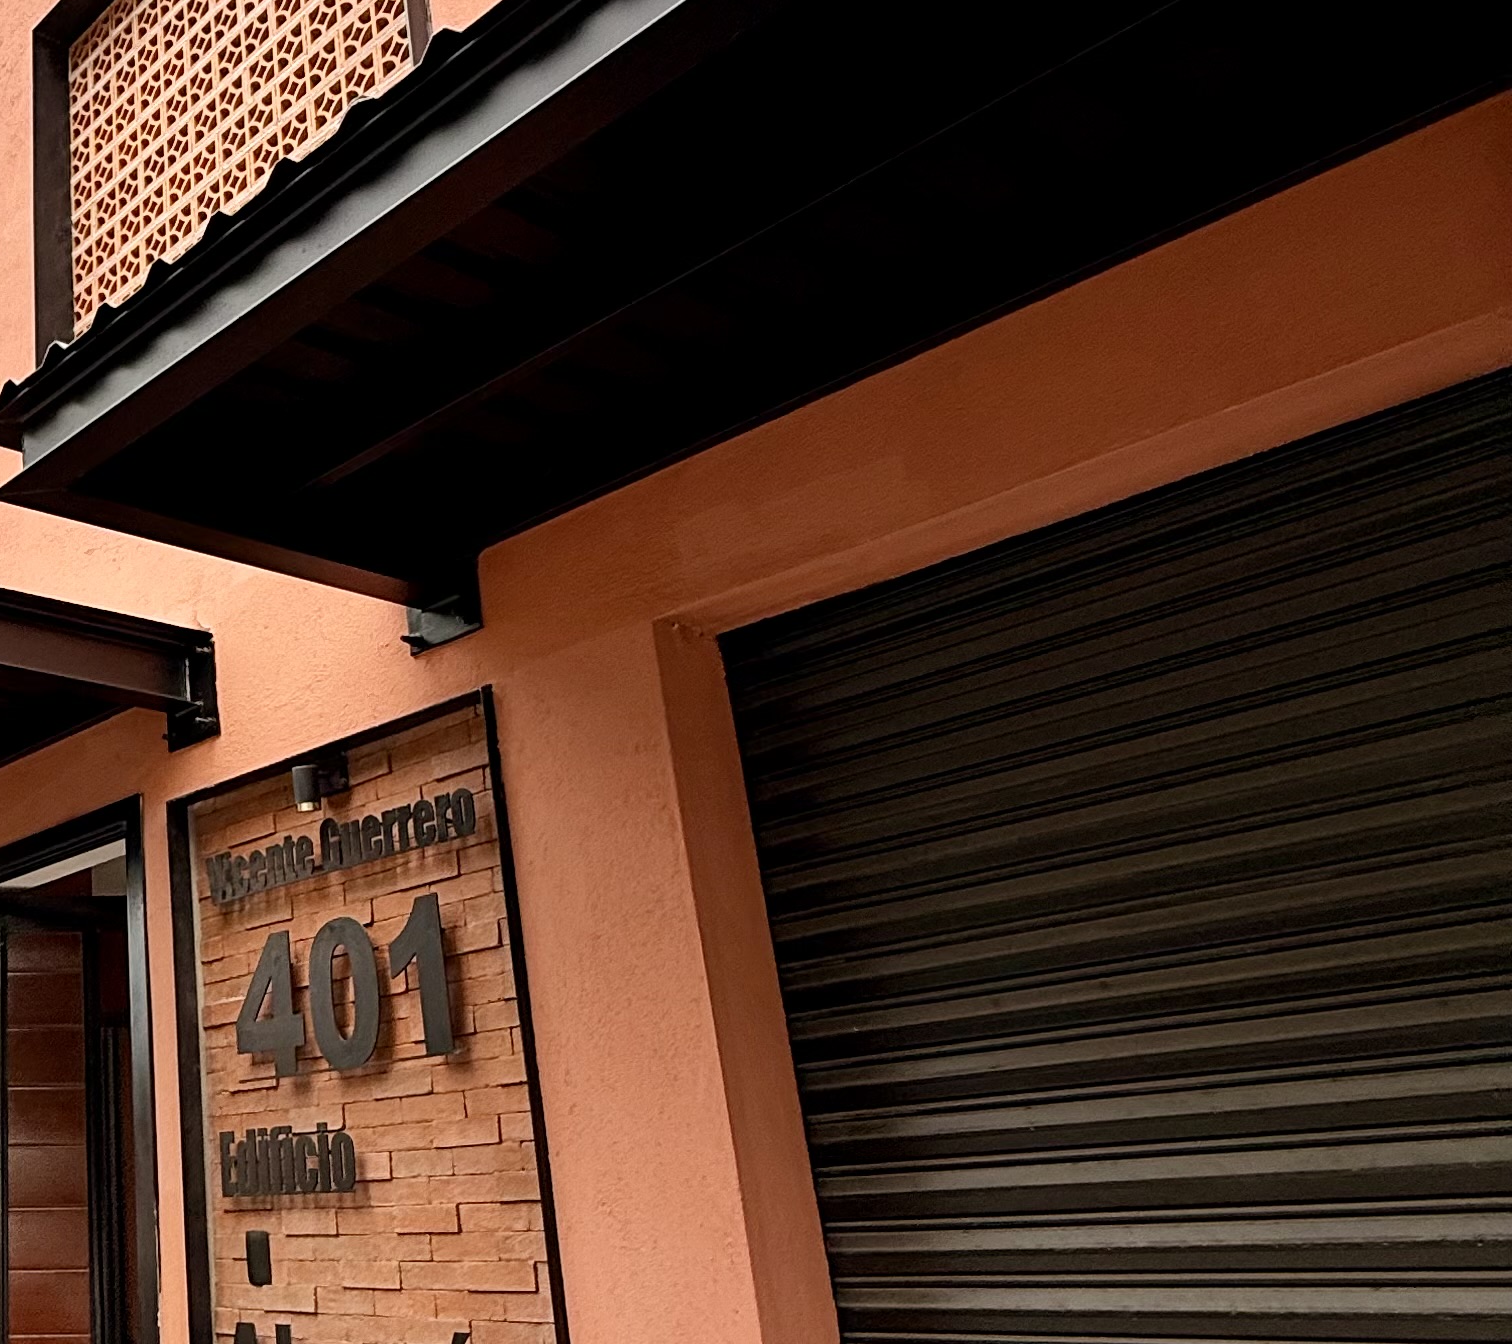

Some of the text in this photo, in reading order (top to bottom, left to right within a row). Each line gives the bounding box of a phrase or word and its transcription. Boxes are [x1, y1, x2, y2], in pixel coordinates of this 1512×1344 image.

[206, 788, 477, 904] Vicente Guerrero
[236, 892, 456, 1078] 401
[219, 1122, 357, 1198] Edificio
